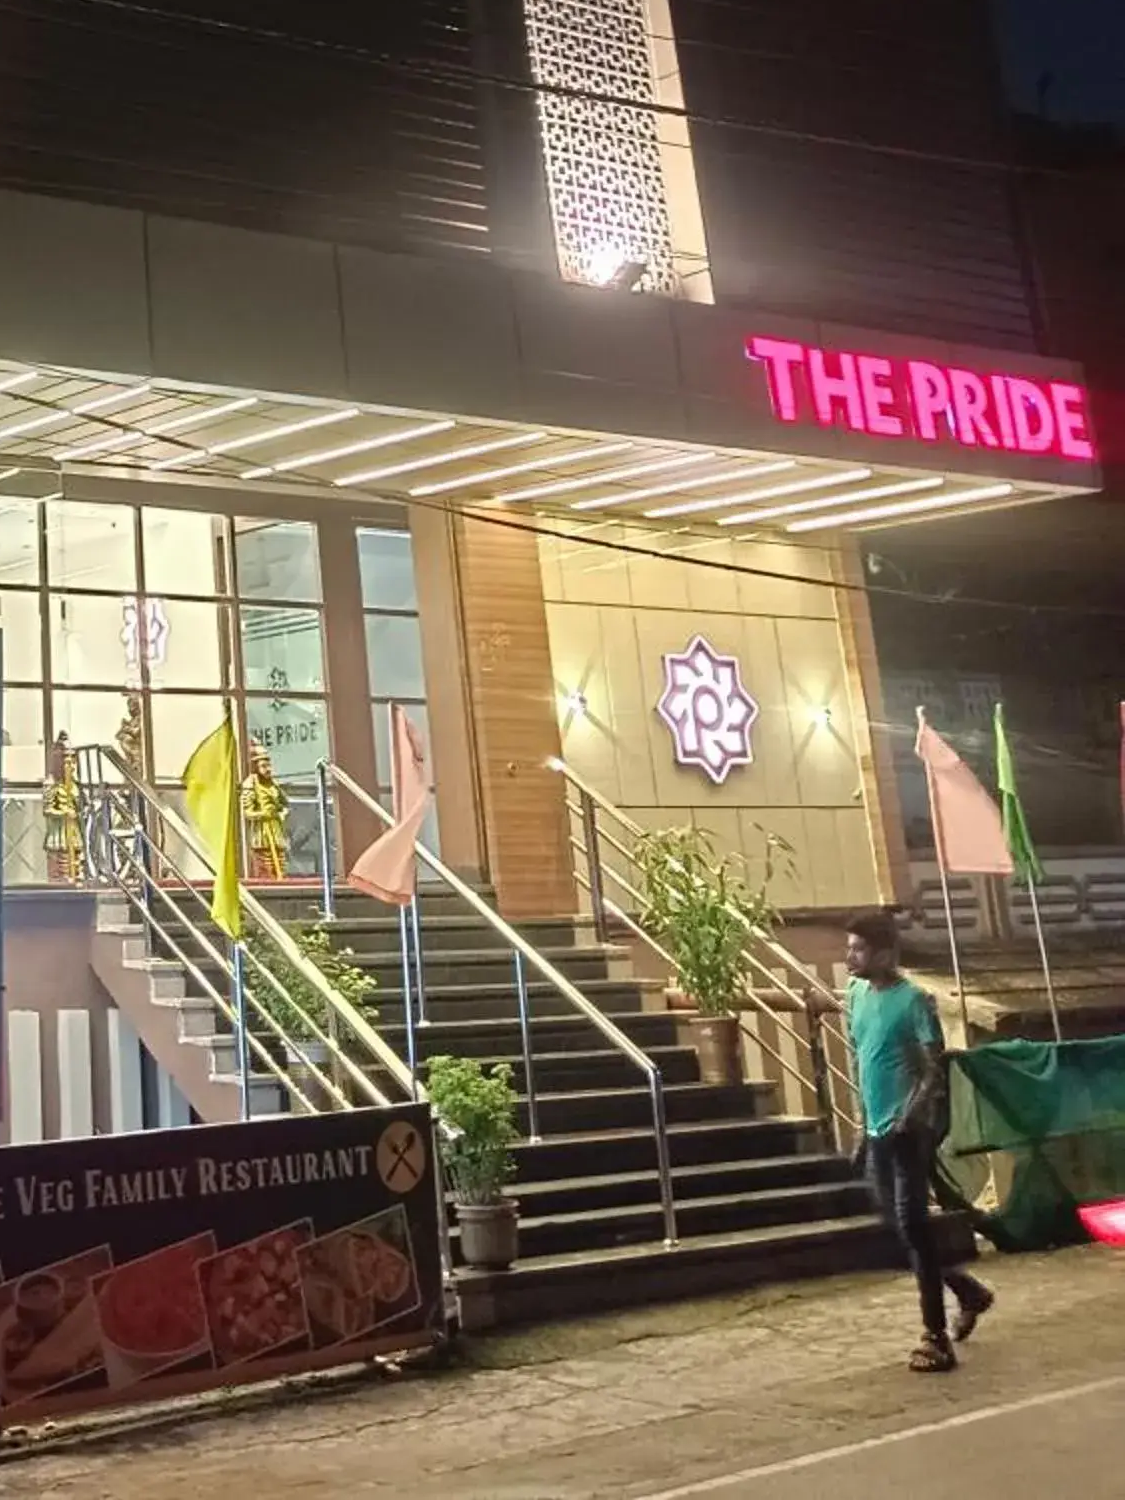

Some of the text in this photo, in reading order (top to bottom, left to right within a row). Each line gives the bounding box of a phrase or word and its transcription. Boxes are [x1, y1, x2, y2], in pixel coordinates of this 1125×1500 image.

[746, 336, 1096, 460] THE PRIDE
[276, 721, 319, 745] PRIDE
